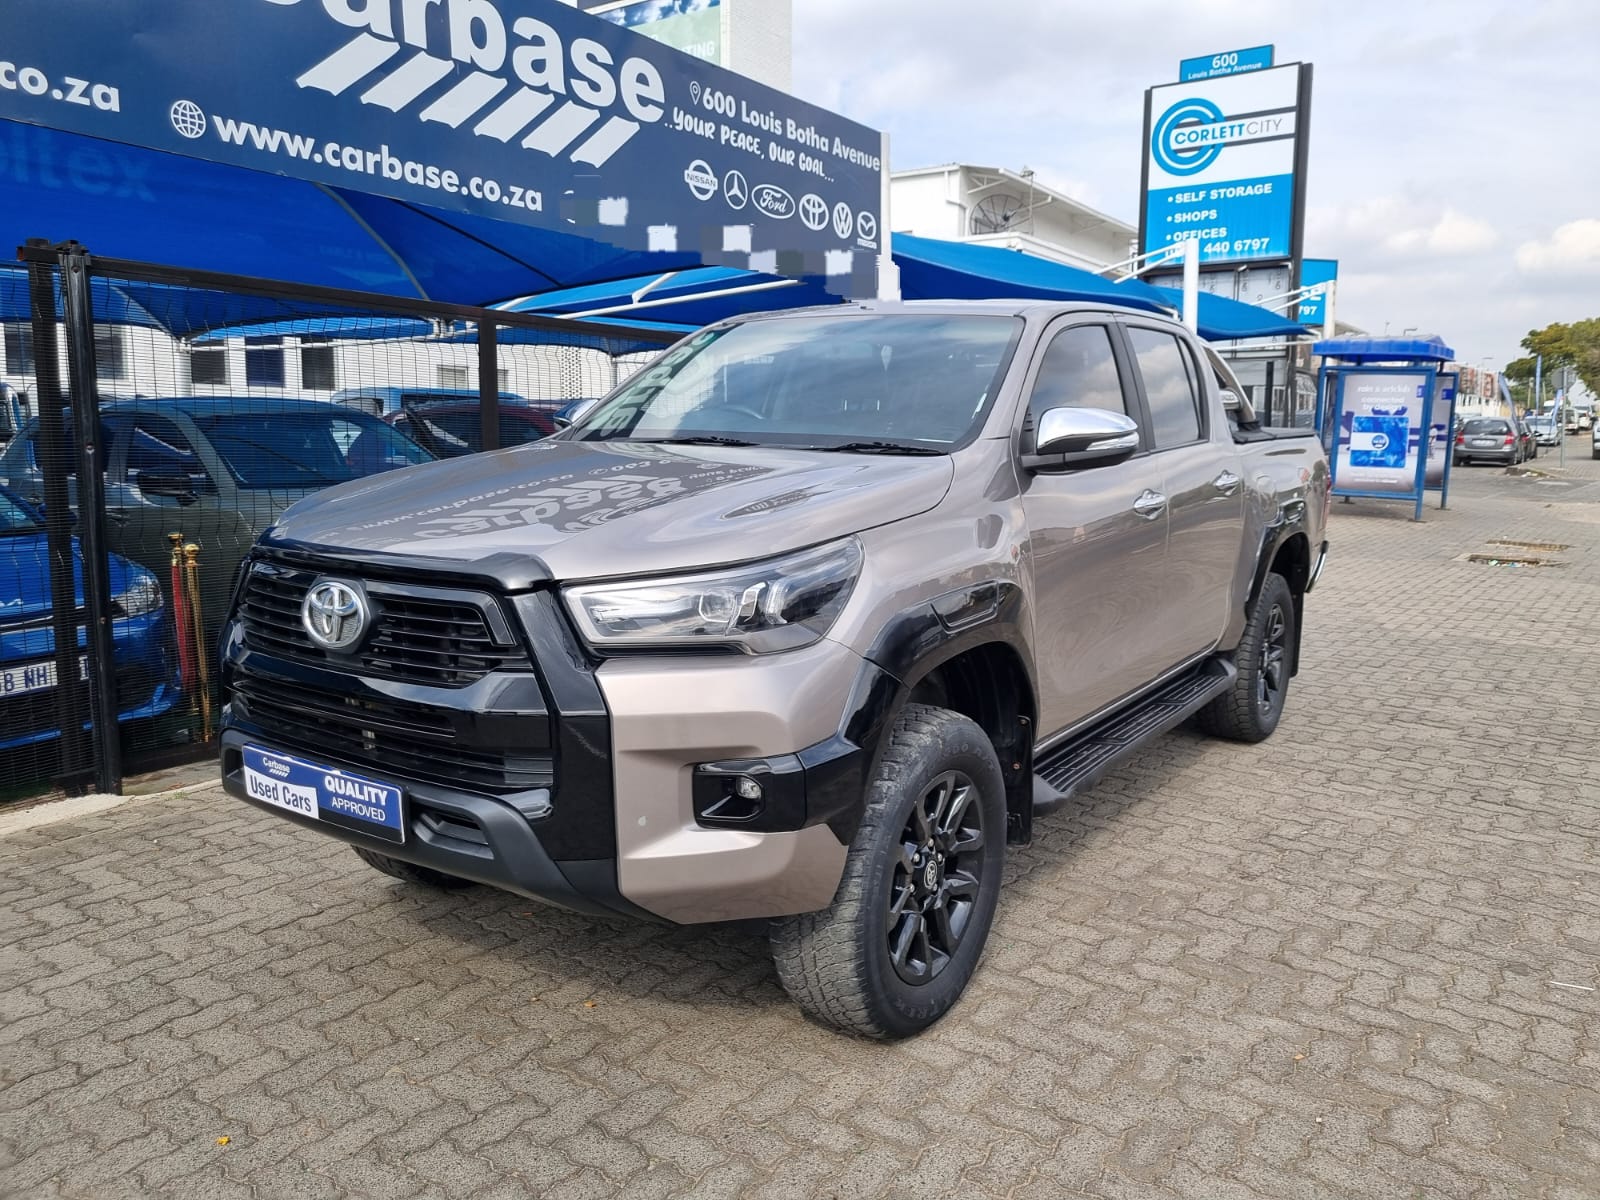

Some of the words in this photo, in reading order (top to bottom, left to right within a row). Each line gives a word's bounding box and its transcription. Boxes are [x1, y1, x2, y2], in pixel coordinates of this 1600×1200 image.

[266, 0, 665, 122] arbase
[1188, 69, 1208, 80] Louis
[1209, 66, 1231, 77] Botha
[1233, 62, 1262, 73] Avenue
[1212, 53, 1238, 69] 600
[702, 87, 736, 118] 600
[741, 100, 783, 136] Louis
[786, 118, 830, 153] Botha
[832, 136, 880, 171] Avenue
[720, 124, 765, 159] PEACE,
[769, 141, 796, 167] OUR
[213, 114, 543, 212] www.carbase.co.za
[686, 172, 717, 189] NISSAN
[759, 188, 788, 214] Ford
[1175, 190, 1206, 204] SELF
[1210, 183, 1273, 200] STORAGE
[1173, 209, 1217, 223] SHOPS
[1203, 241, 1230, 254] 440
[1234, 237, 1270, 251] 6797
[263, 757, 290, 773] Carbase
[250, 774, 278, 801] Used
[282, 785, 312, 813] Cars
[324, 775, 388, 806] QUALITY
[331, 797, 386, 822] APPROVED
